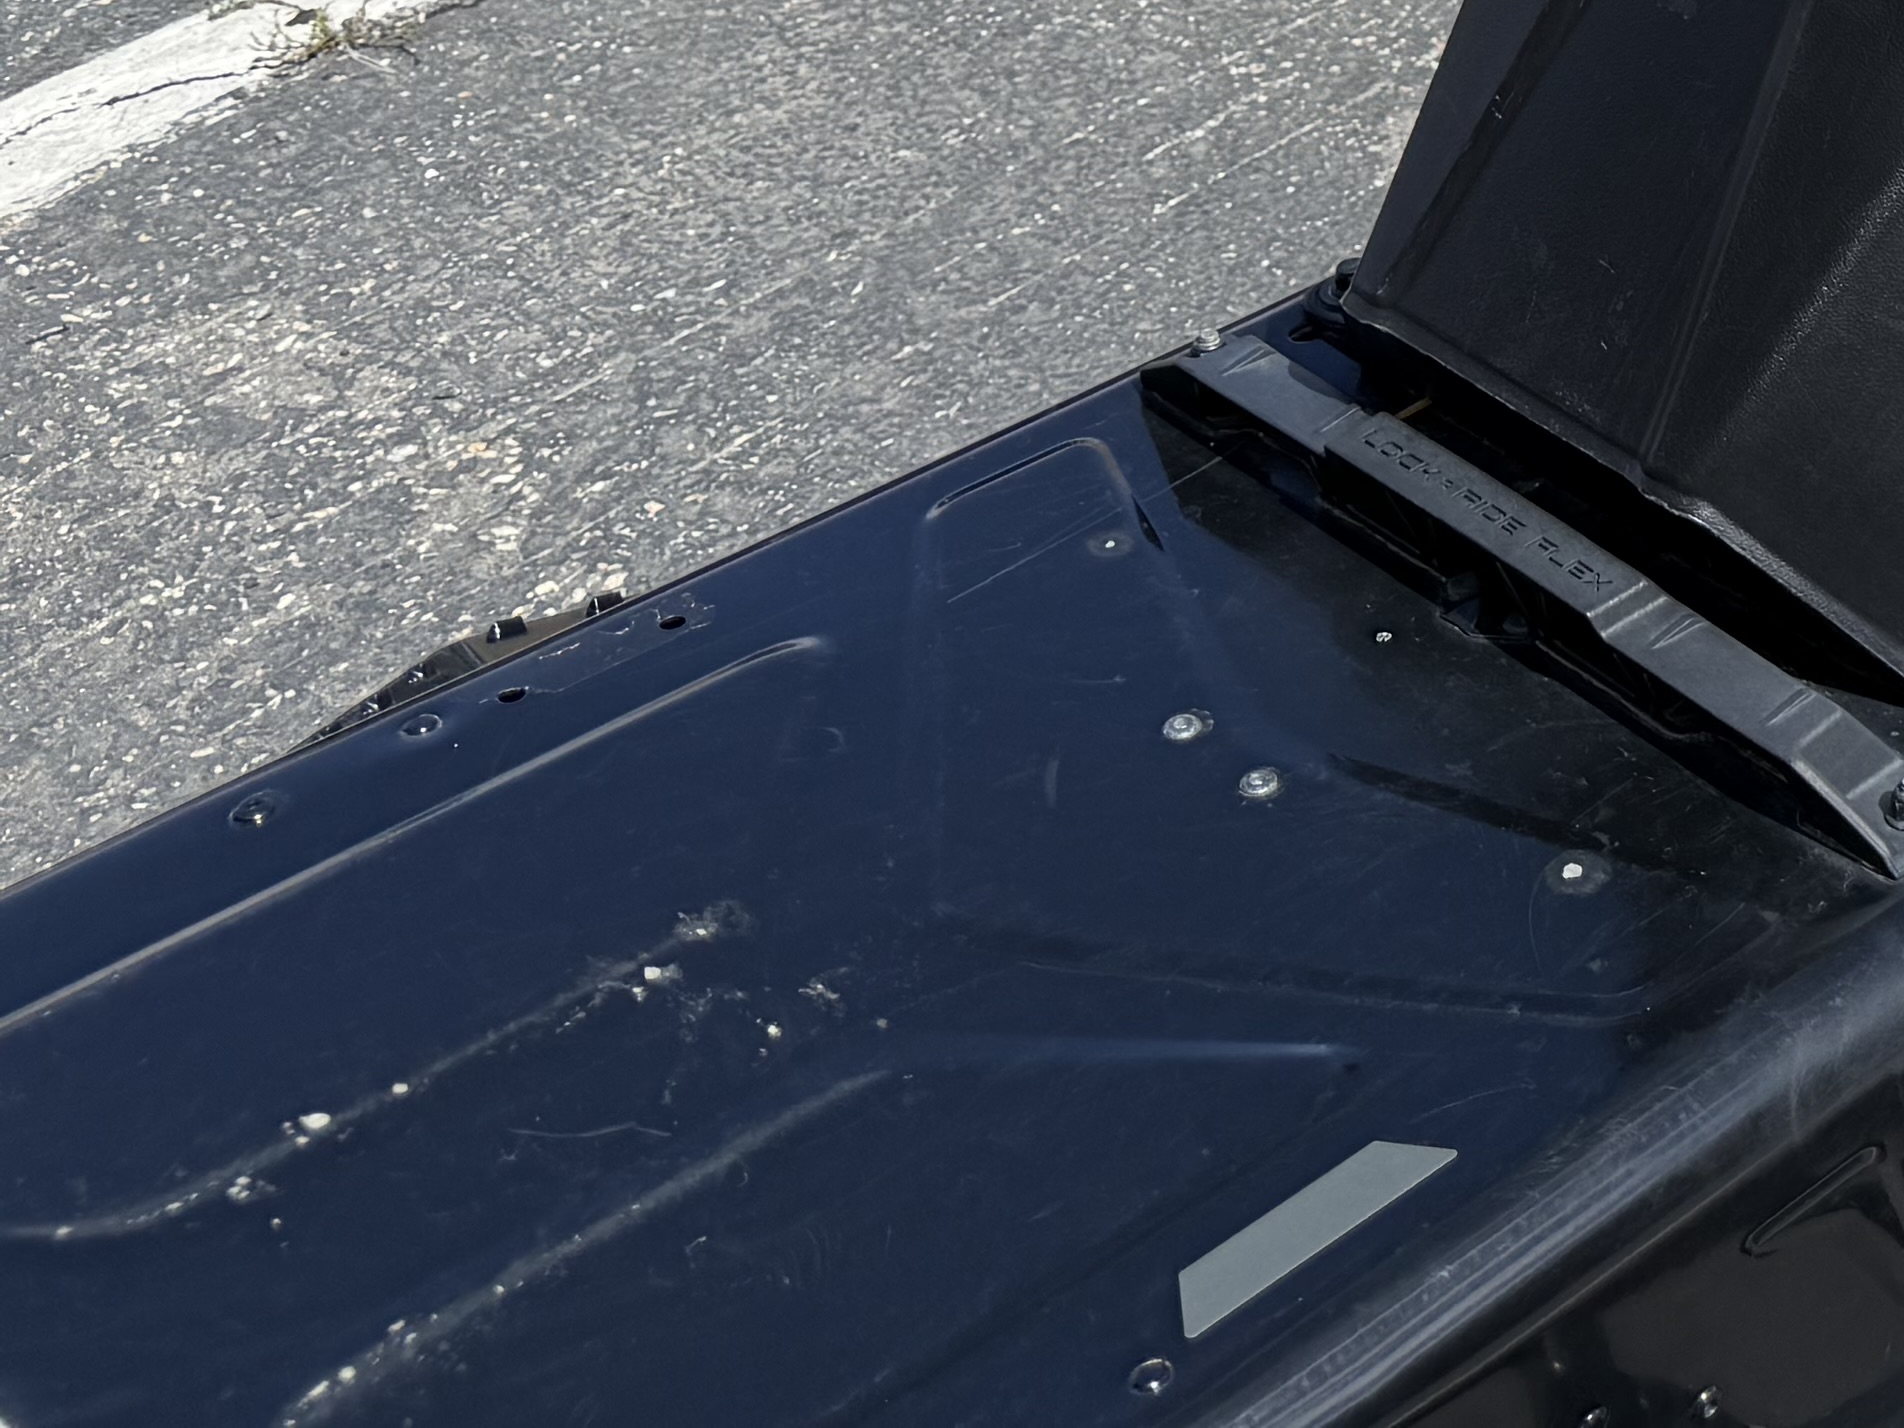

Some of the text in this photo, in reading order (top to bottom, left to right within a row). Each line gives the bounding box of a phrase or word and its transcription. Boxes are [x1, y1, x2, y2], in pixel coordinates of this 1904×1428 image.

[1361, 428, 1442, 482] LOCK
[1449, 486, 1528, 537] RIDE
[1524, 535, 1614, 593] FLEX
